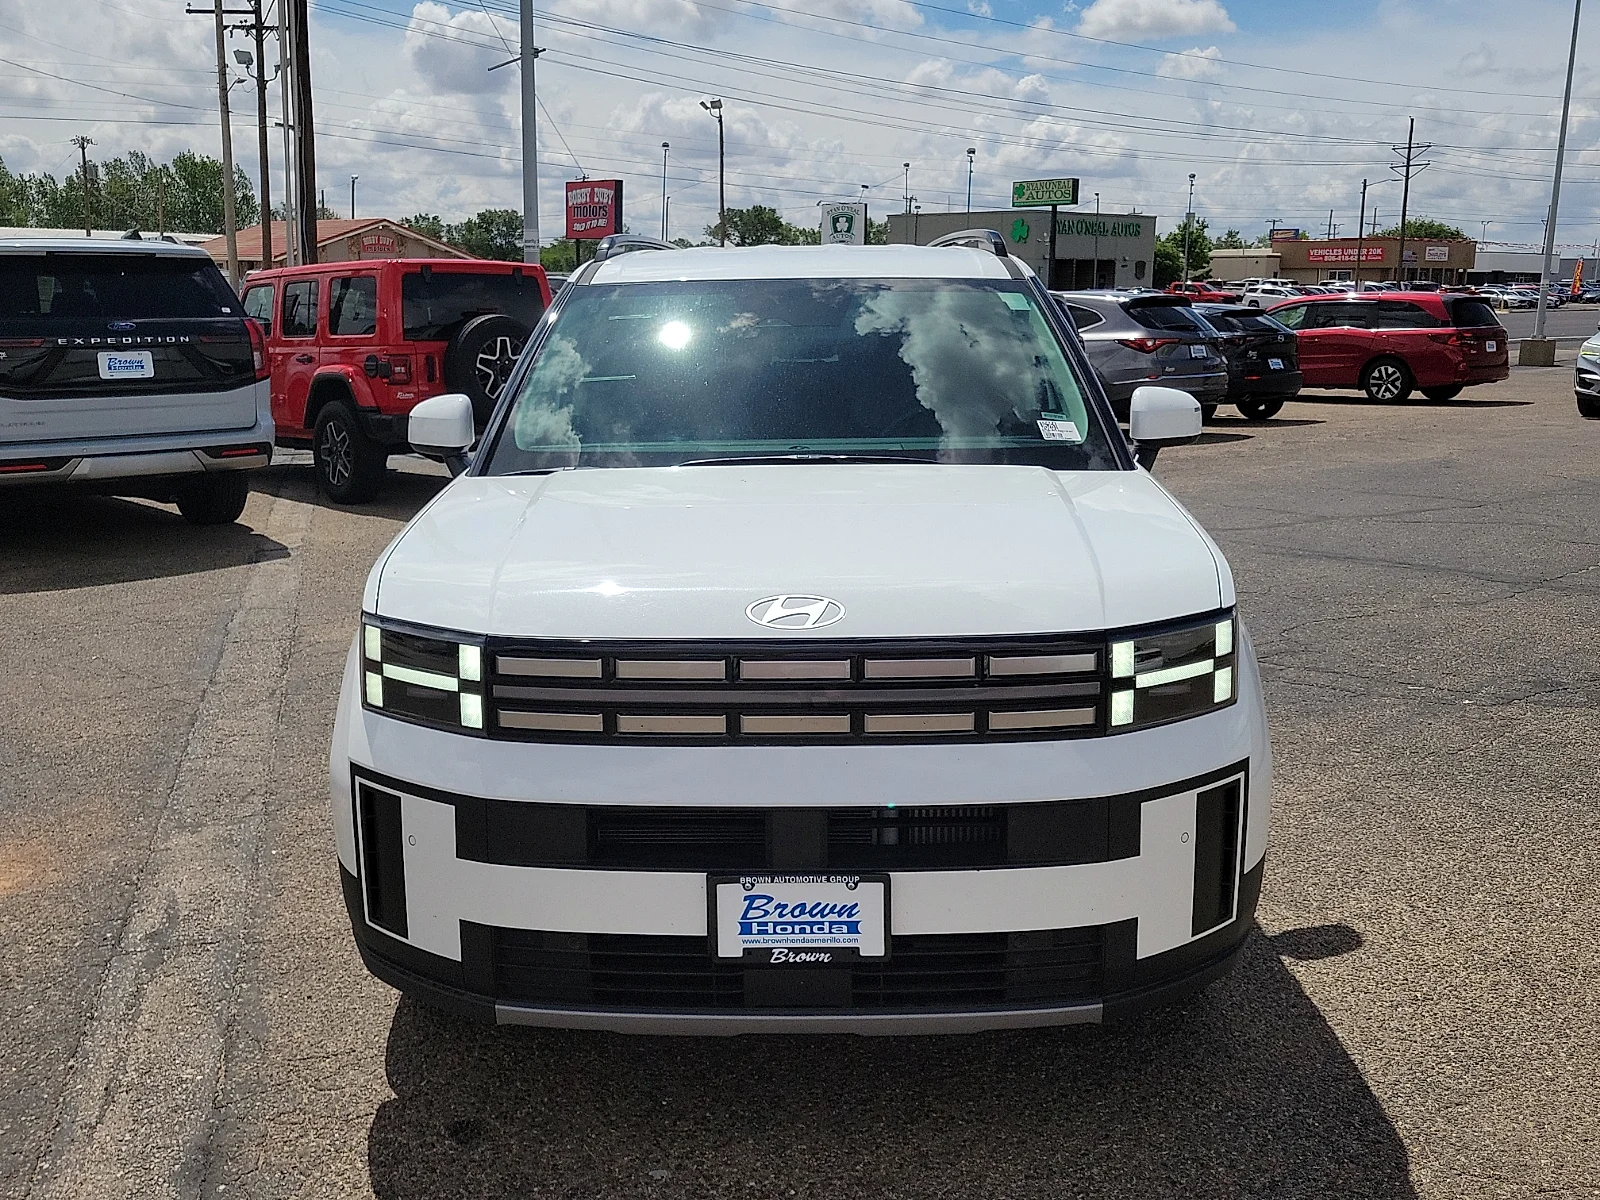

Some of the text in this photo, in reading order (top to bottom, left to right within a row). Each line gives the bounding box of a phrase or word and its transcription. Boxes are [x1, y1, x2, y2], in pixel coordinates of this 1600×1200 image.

[1026, 190, 1071, 201] AUTOS
[573, 204, 608, 218] motors
[1111, 222, 1141, 237] AUTOS
[1309, 248, 1343, 256] VEHICLES
[57, 335, 190, 345] EXPEDITION
[107, 357, 145, 366] Brown
[739, 875, 861, 885] BROWN AUTOMOTIVE GROUP
[740, 894, 861, 921] Brown
[751, 922, 849, 935] Honda
[741, 936, 860, 945] www.brownhondaamarillo.com
[769, 948, 833, 964] Brown
